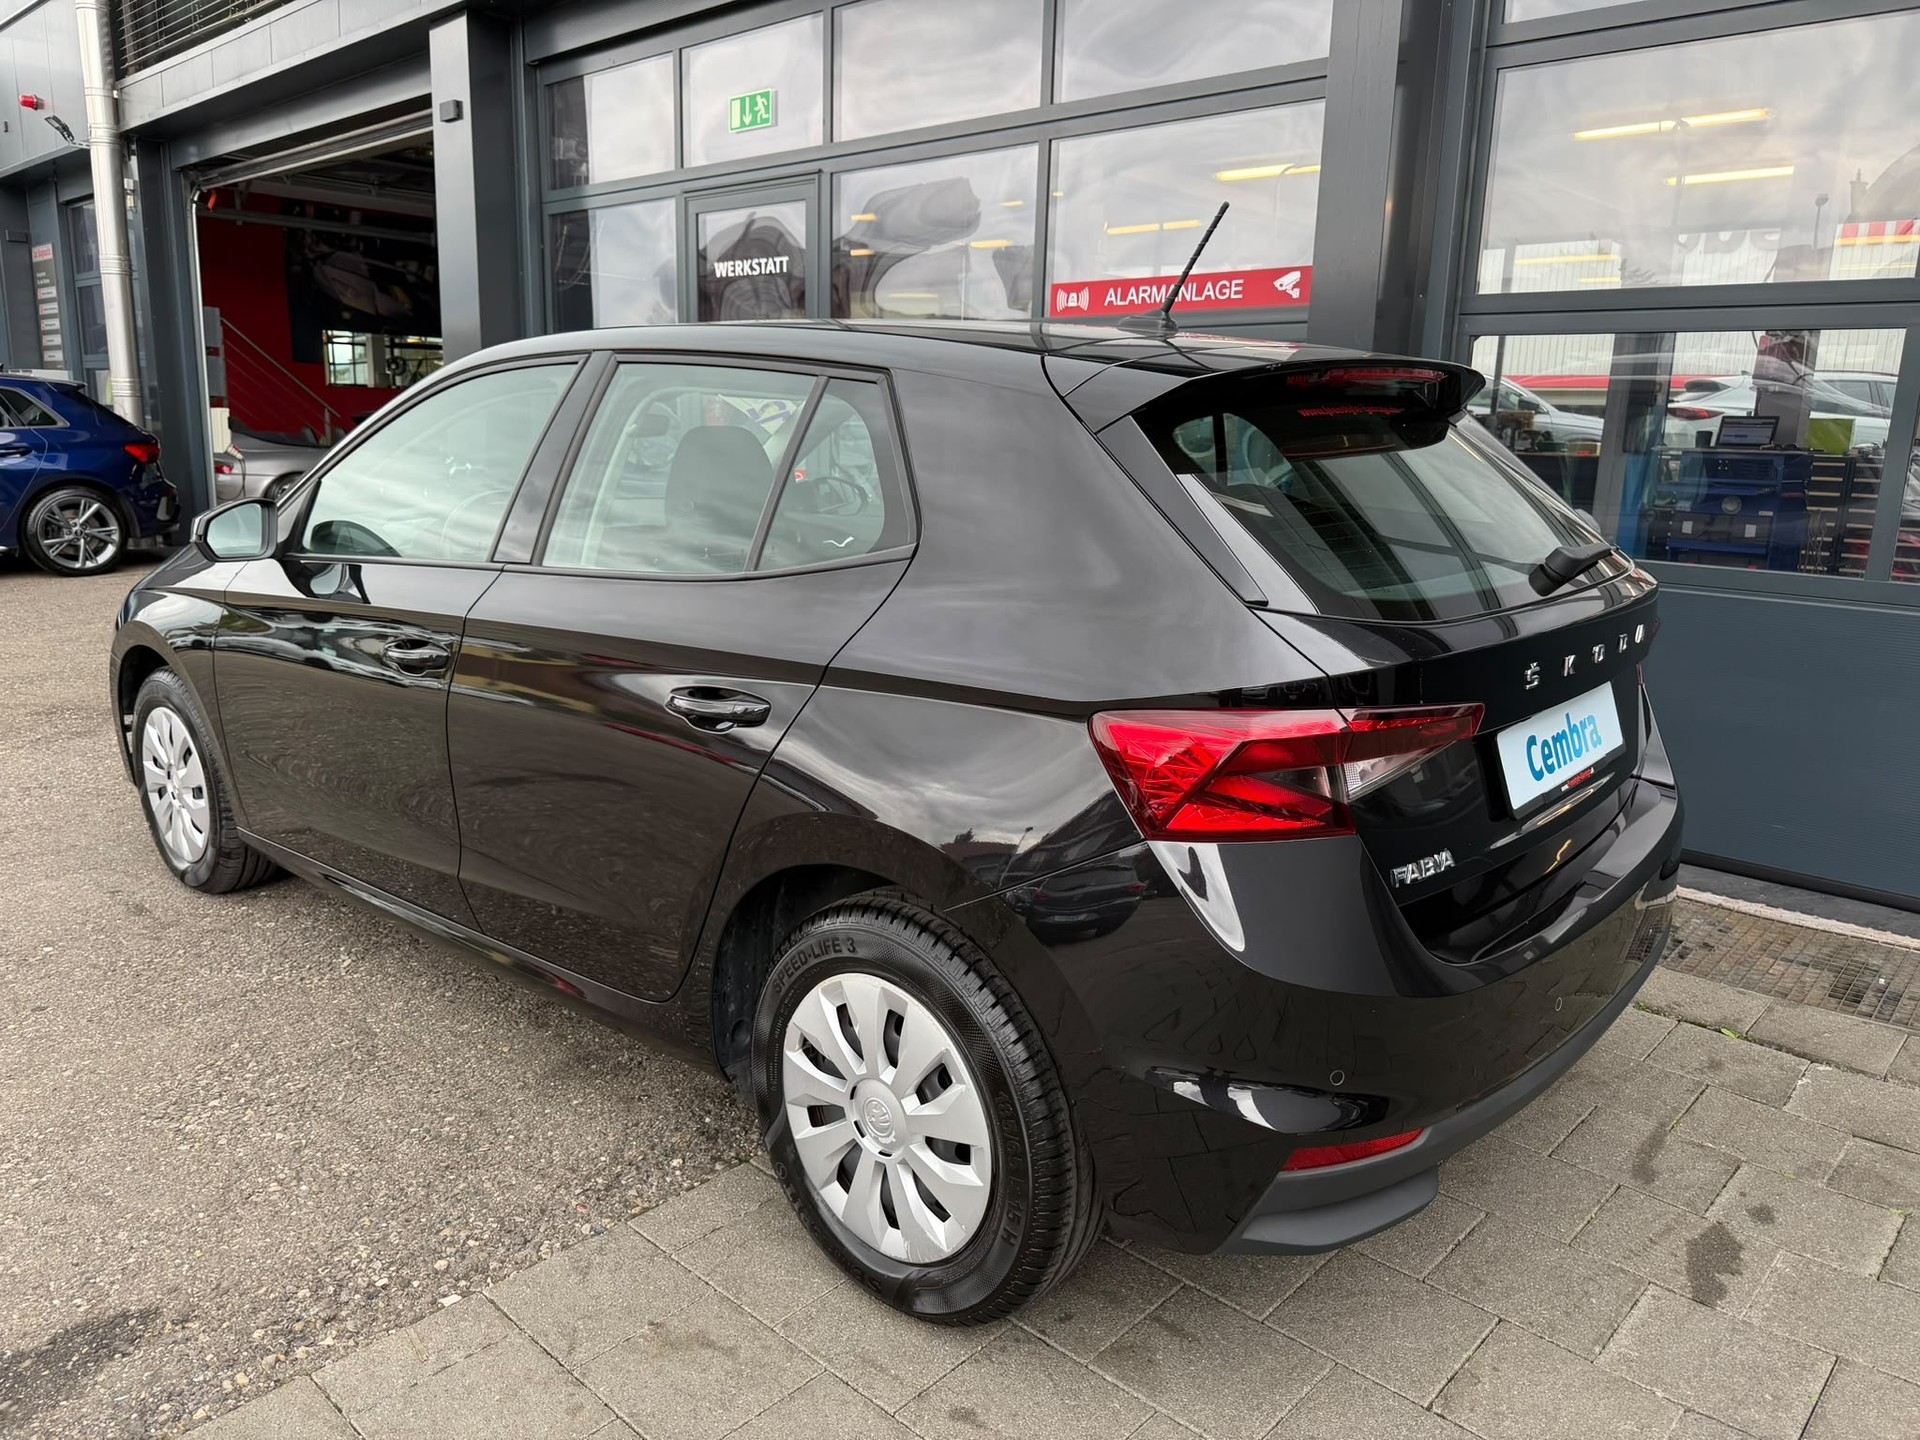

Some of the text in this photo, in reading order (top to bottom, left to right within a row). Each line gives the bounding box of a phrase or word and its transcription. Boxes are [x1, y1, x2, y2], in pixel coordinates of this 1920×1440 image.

[714, 256, 789, 278] WERKSTATT
[1526, 712, 1602, 781] Cembra
[1390, 848, 1455, 888] FABIA
[772, 937, 857, 994] SPEED-LIFE 3
